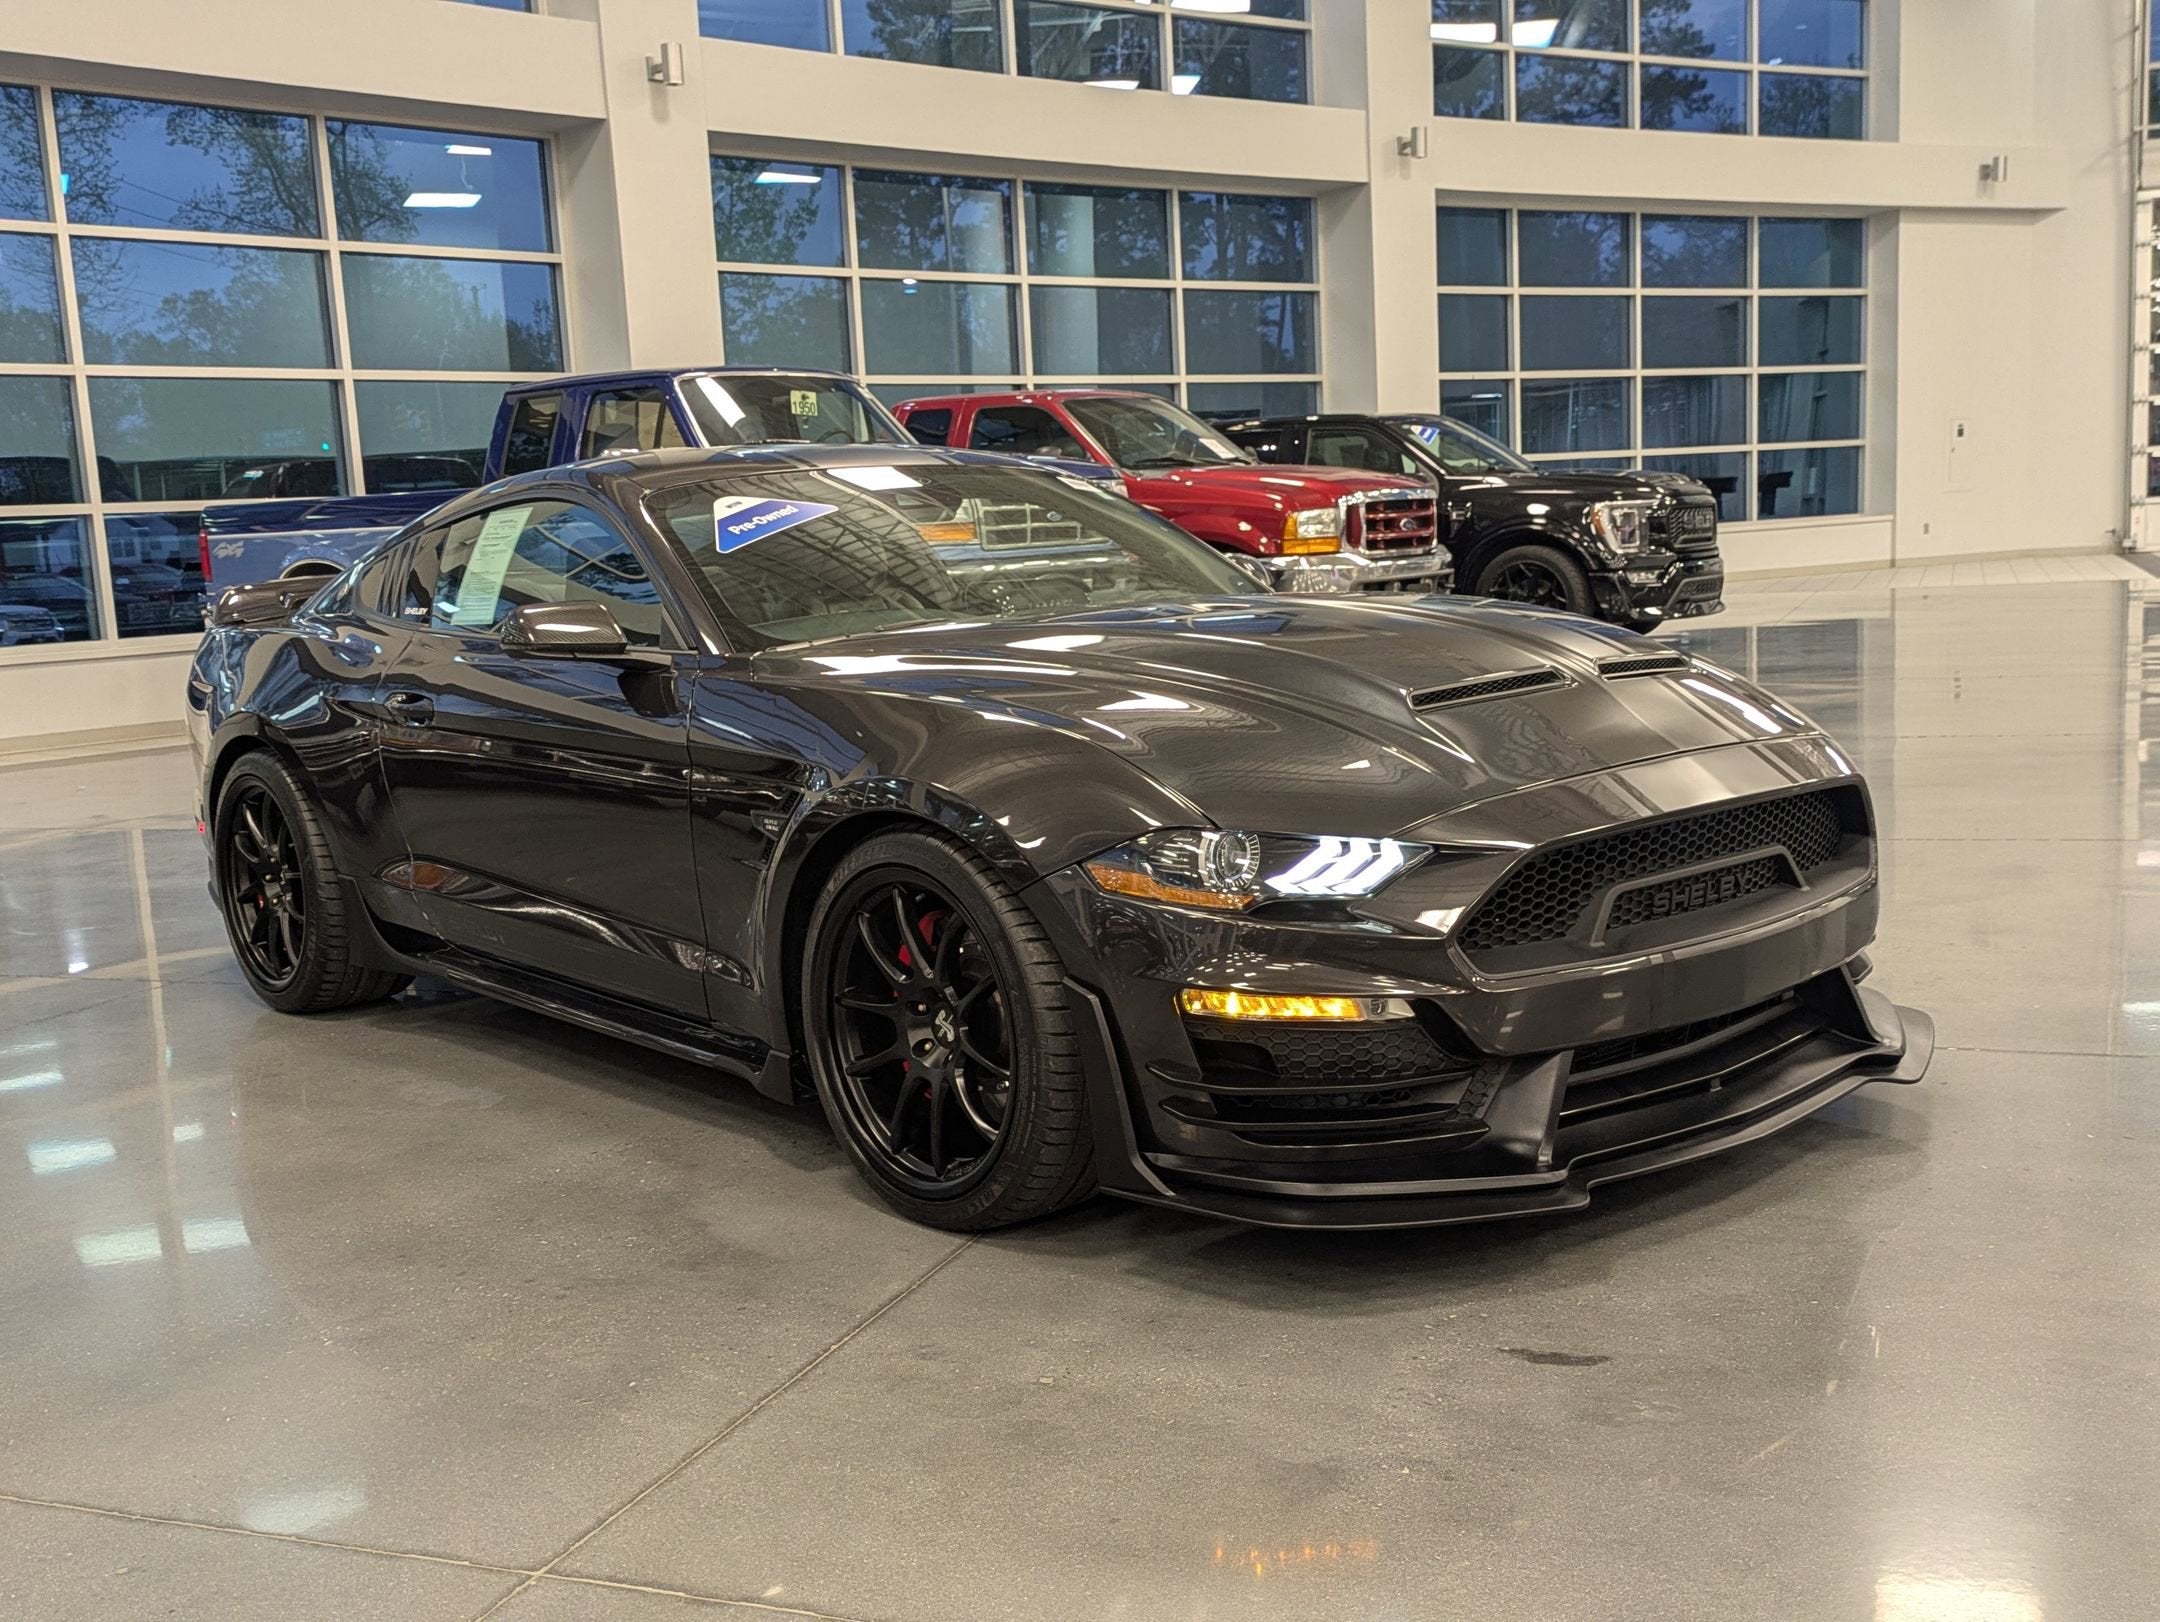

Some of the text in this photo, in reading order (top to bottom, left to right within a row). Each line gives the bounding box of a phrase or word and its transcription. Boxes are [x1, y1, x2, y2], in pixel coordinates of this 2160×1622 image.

[792, 401, 816, 415] 1950
[727, 504, 799, 535] Pre-Owned
[1652, 872, 1748, 915] SHELBY
